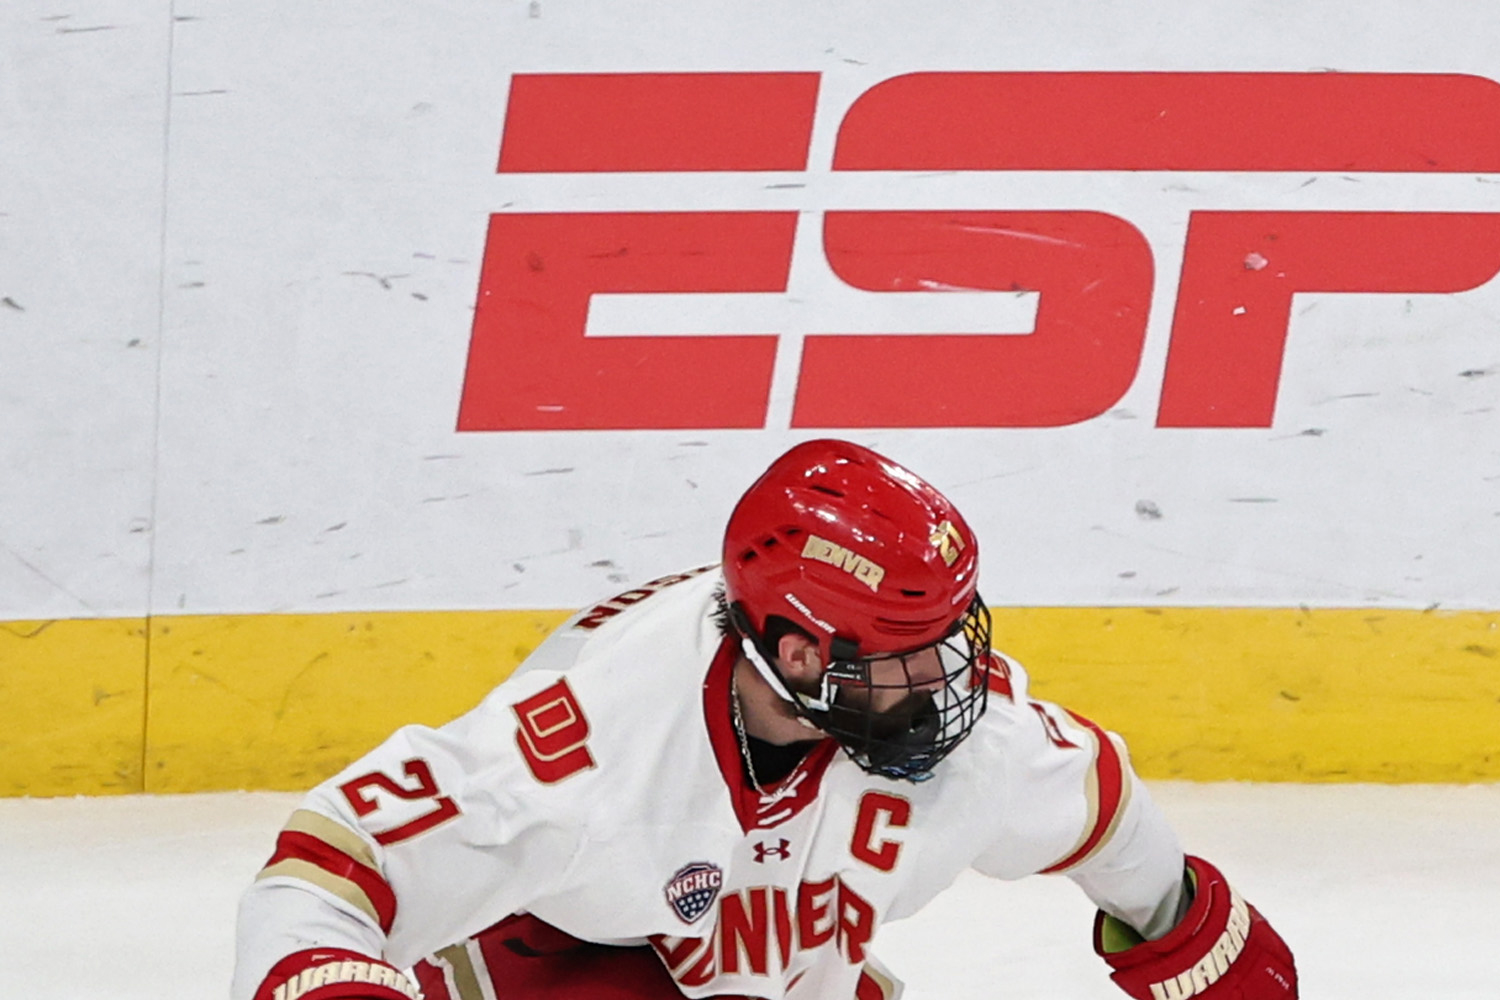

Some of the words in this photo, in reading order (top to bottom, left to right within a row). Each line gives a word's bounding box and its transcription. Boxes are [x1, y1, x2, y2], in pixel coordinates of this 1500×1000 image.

[801, 534, 886, 593] DENVER
[336, 756, 464, 848] 21
[849, 787, 911, 873] C
[667, 869, 722, 902] NCHC
